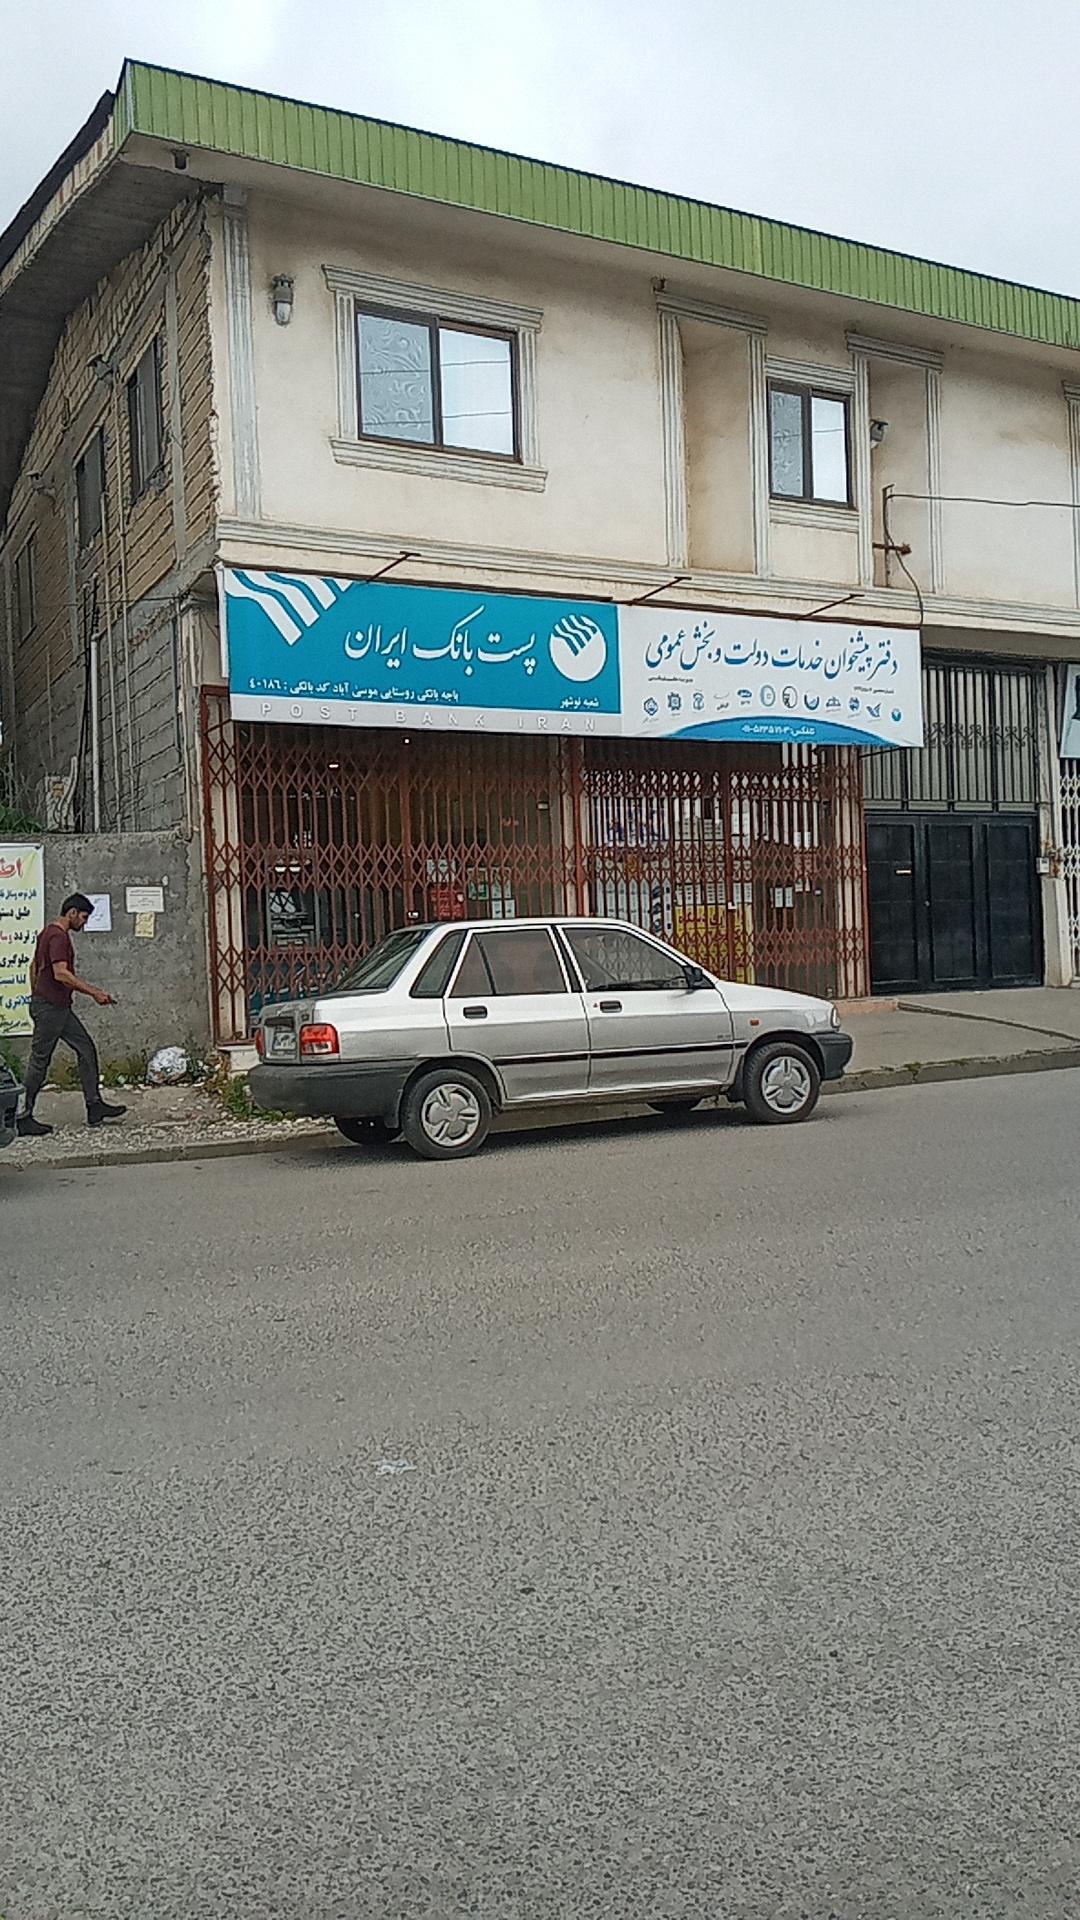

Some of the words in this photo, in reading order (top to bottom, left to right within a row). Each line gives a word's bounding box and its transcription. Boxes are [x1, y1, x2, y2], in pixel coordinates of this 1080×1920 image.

[345, 623, 407, 668] ایران
[413, 605, 484, 675] بانک
[477, 633, 536, 675] پست
[645, 630, 686, 669] عمومی
[680, 620, 716, 671] بخش
[724, 639, 768, 667] دولت
[713, 647, 721, 664] و
[771, 640, 822, 671] خدمات
[824, 630, 872, 680] پیشخوان
[867, 639, 898, 681] دفتر
[290, 681, 314, 695] بانکی
[315, 682, 331, 693] کد
[417, 688, 439, 702] بانکی
[441, 689, 459, 702] باجه
[261, 702, 358, 721] POST
[395, 709, 485, 727] BANK
[518, 715, 596, 731] IRAN
[560, 695, 581, 710] نوشهر
[583, 696, 599, 709] شعبه
